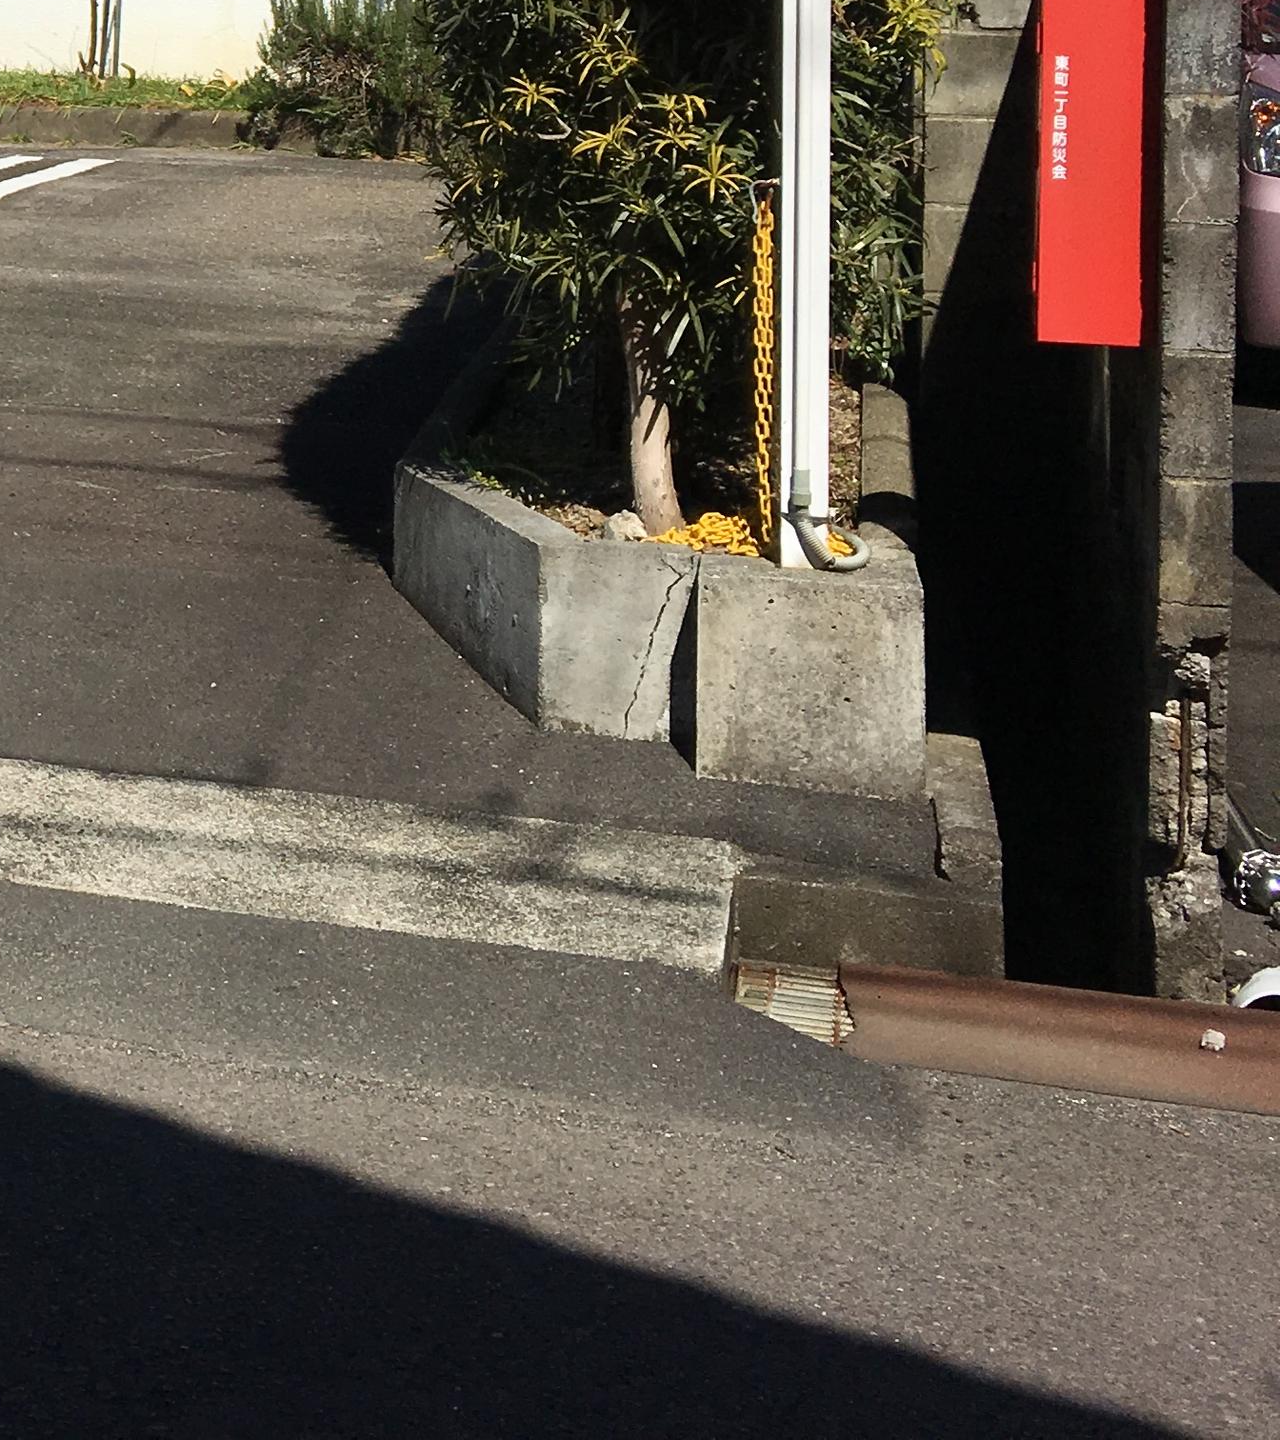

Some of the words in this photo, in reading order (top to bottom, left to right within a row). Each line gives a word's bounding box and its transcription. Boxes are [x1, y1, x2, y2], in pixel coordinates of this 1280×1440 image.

[1052, 55, 1070, 180] 東町一丁目防災会
